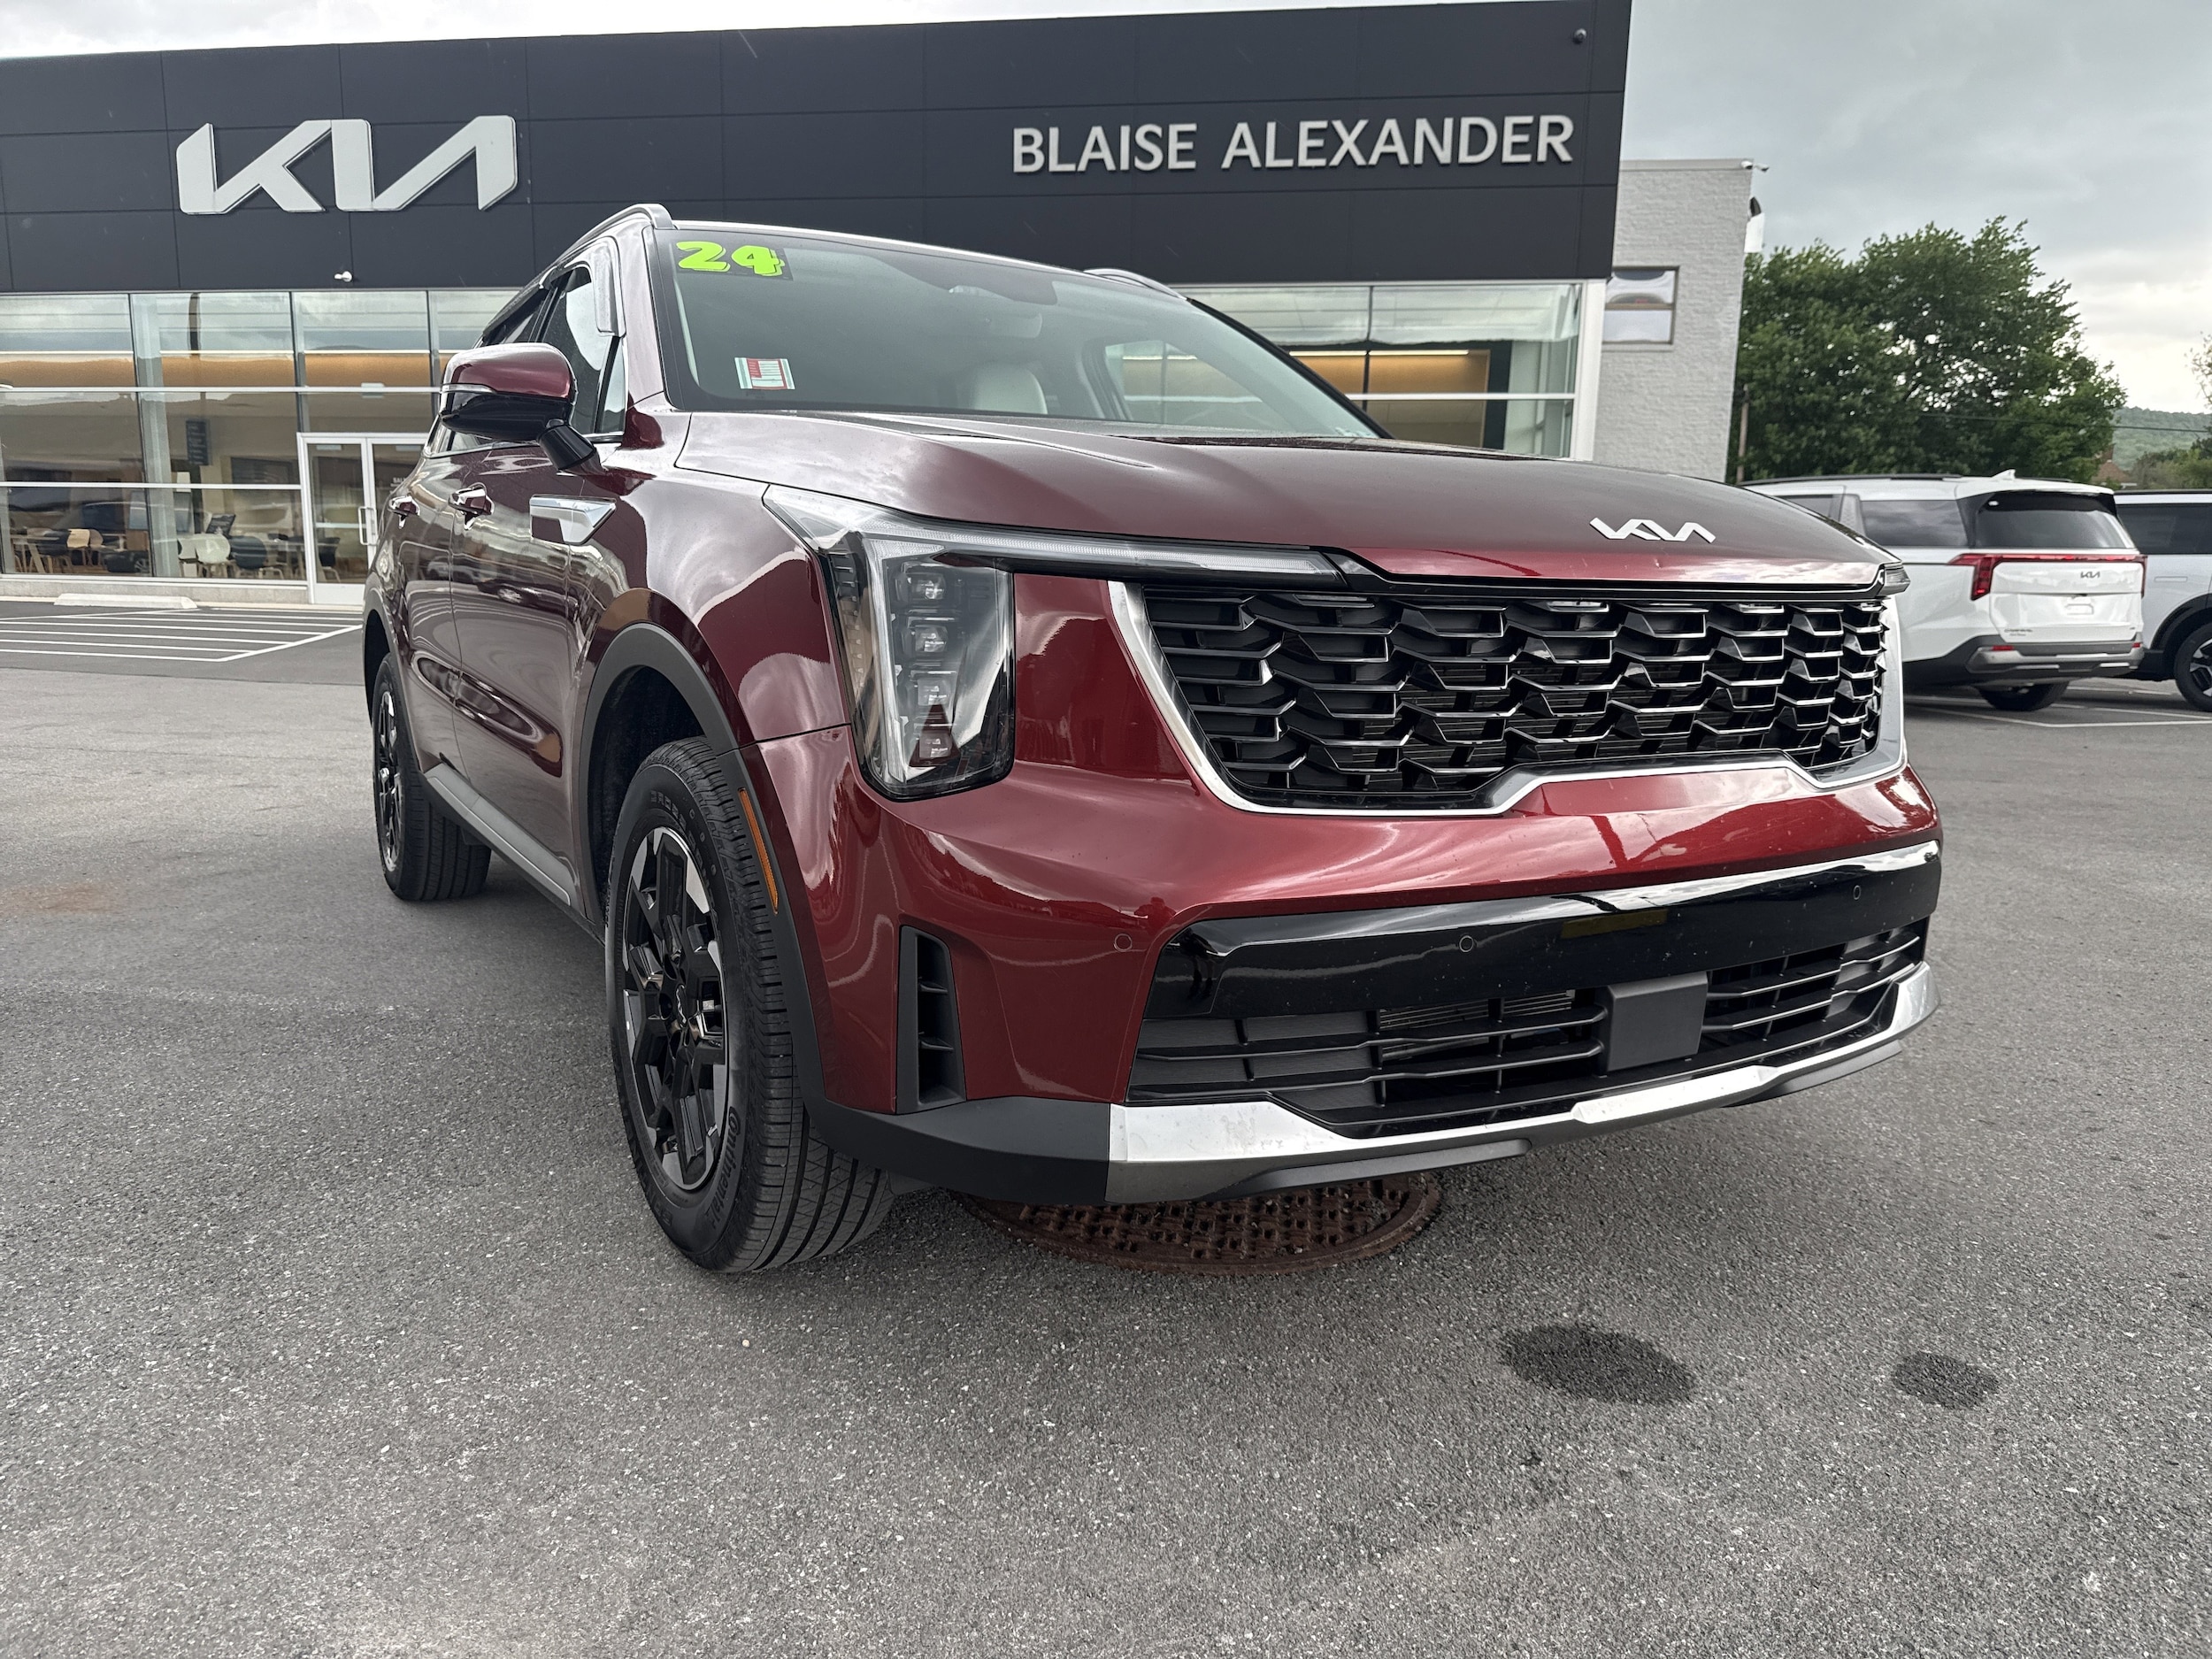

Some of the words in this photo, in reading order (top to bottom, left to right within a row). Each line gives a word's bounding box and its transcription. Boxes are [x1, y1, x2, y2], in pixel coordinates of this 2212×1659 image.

[176, 115, 518, 215] KIA
[1012, 123, 1197, 174] BLAISE
[1221, 115, 1574, 170] ALEXANDER
[676, 241, 785, 277] 24
[1590, 517, 1716, 543] KIA
